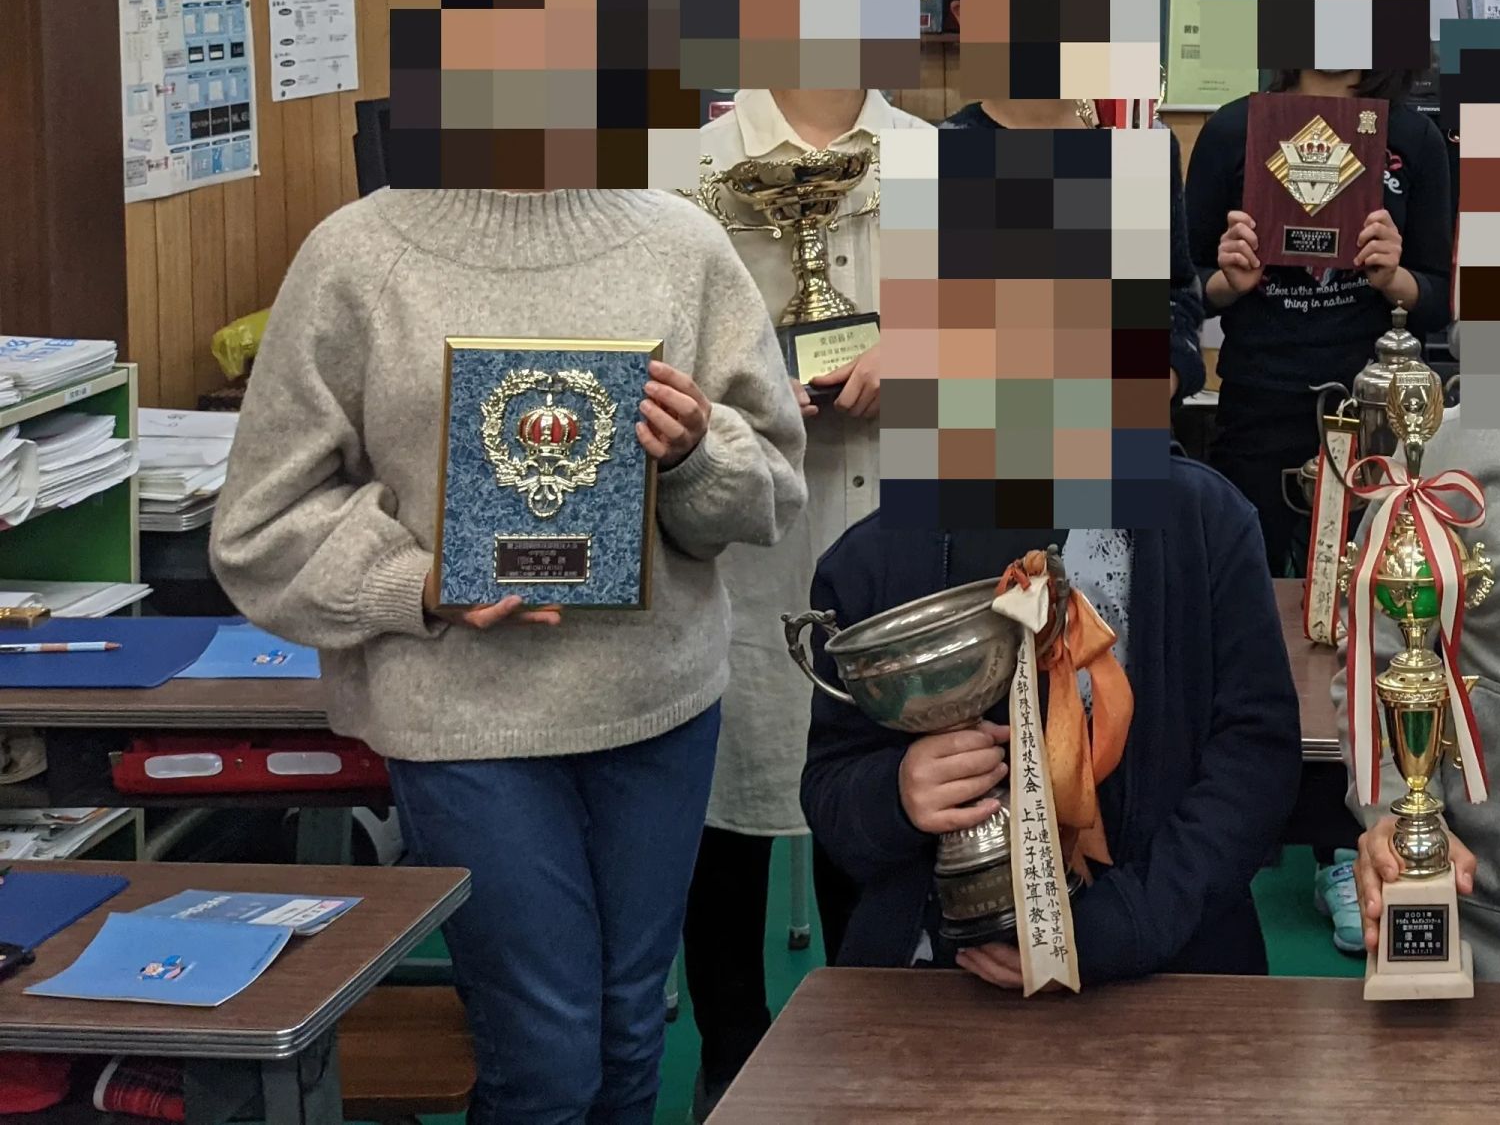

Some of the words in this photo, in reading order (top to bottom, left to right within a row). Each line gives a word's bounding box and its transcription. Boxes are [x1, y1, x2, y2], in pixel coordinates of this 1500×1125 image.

[1316, 281, 1338, 293] most
[1284, 297, 1308, 313] thing
[1311, 298, 1321, 308] in
[1323, 295, 1355, 307] nature
